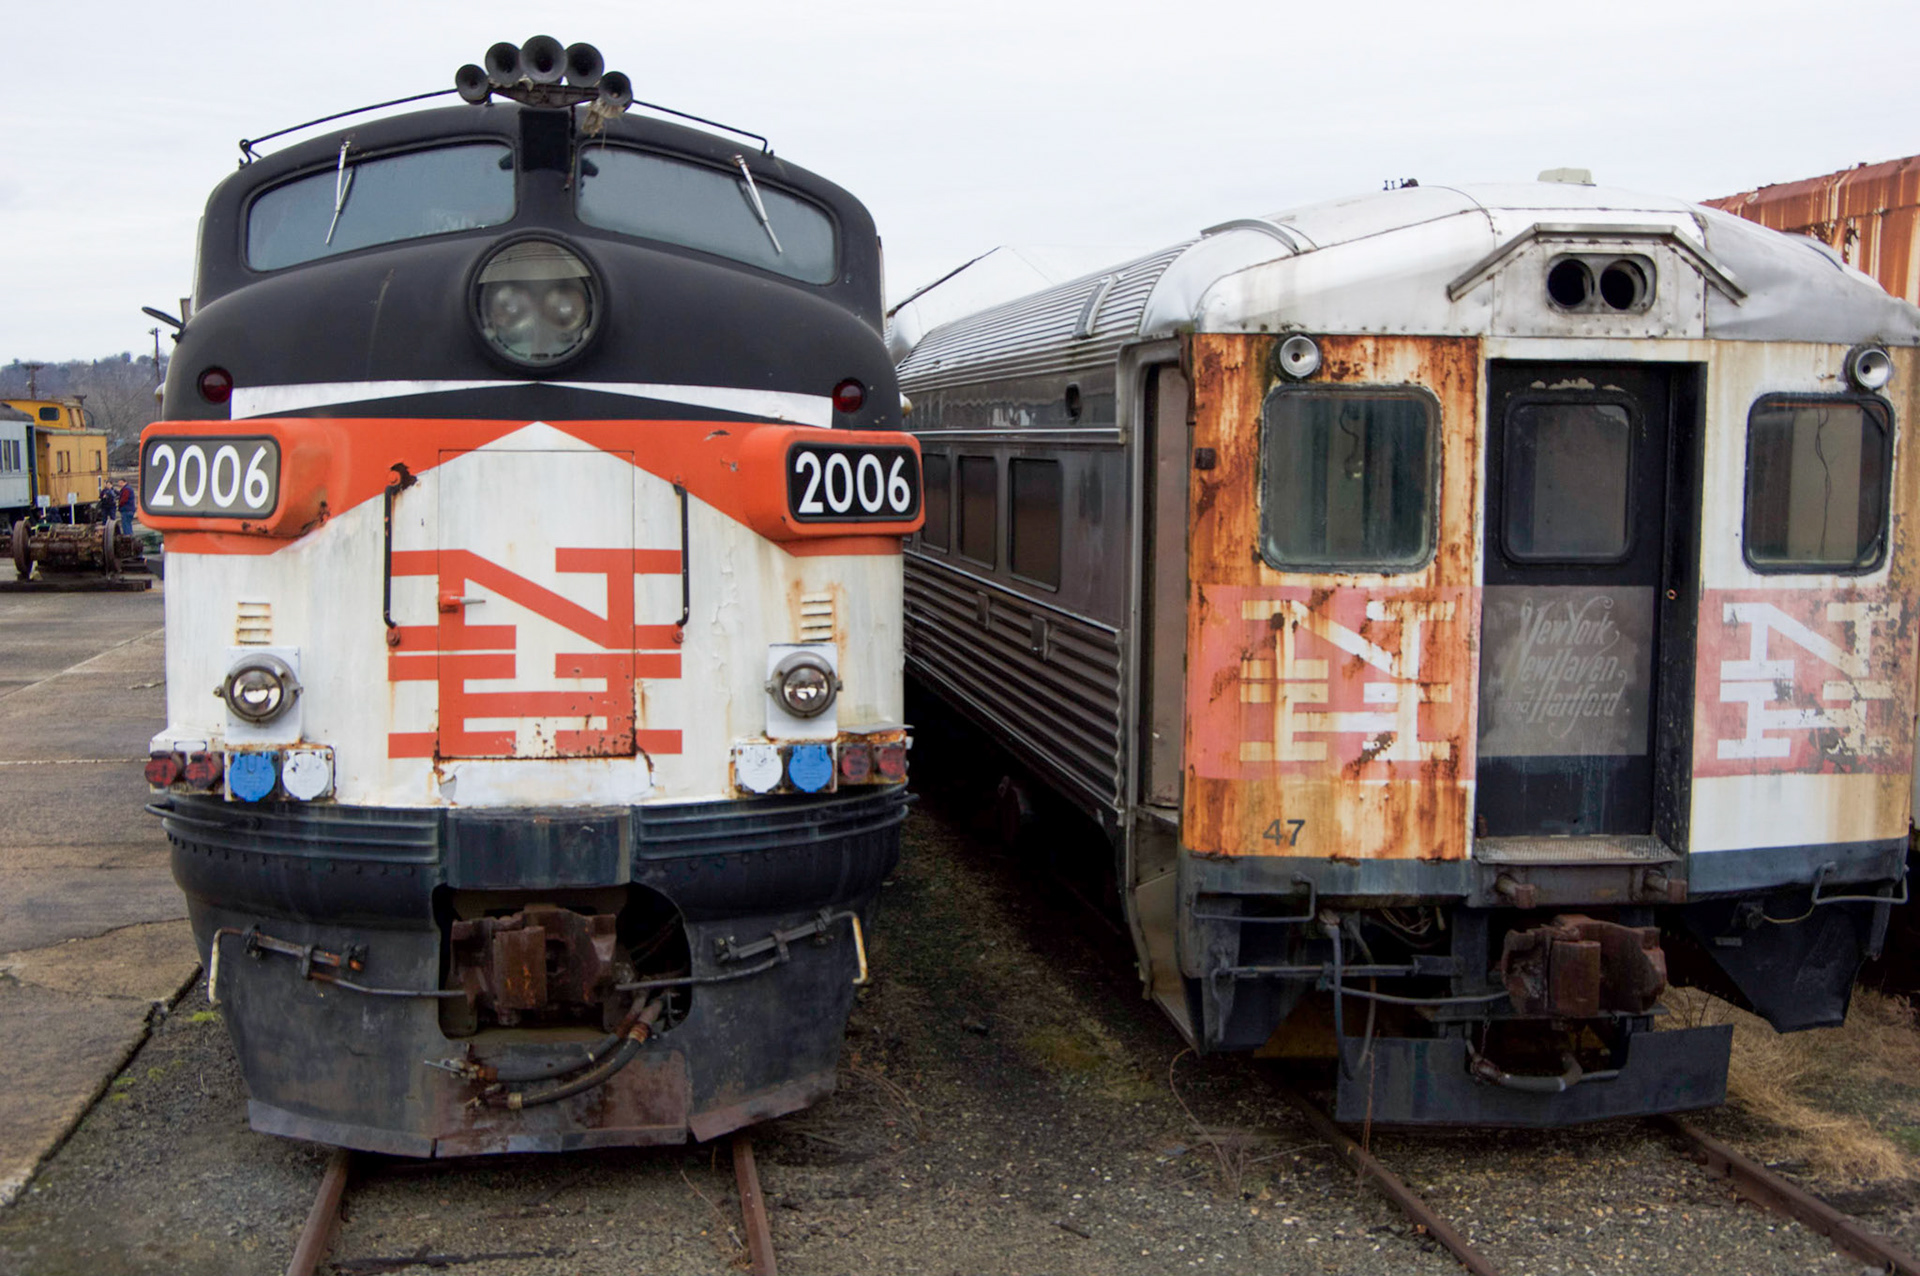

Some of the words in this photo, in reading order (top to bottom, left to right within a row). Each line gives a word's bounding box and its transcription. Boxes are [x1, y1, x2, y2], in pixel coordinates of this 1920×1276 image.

[150, 444, 269, 509] 2006
[795, 451, 911, 513] 2006
[1565, 595, 1615, 646] York
[1546, 632, 1620, 685] Haven
[1526, 669, 1628, 738] Hartford
[1262, 818, 1306, 847] 47
